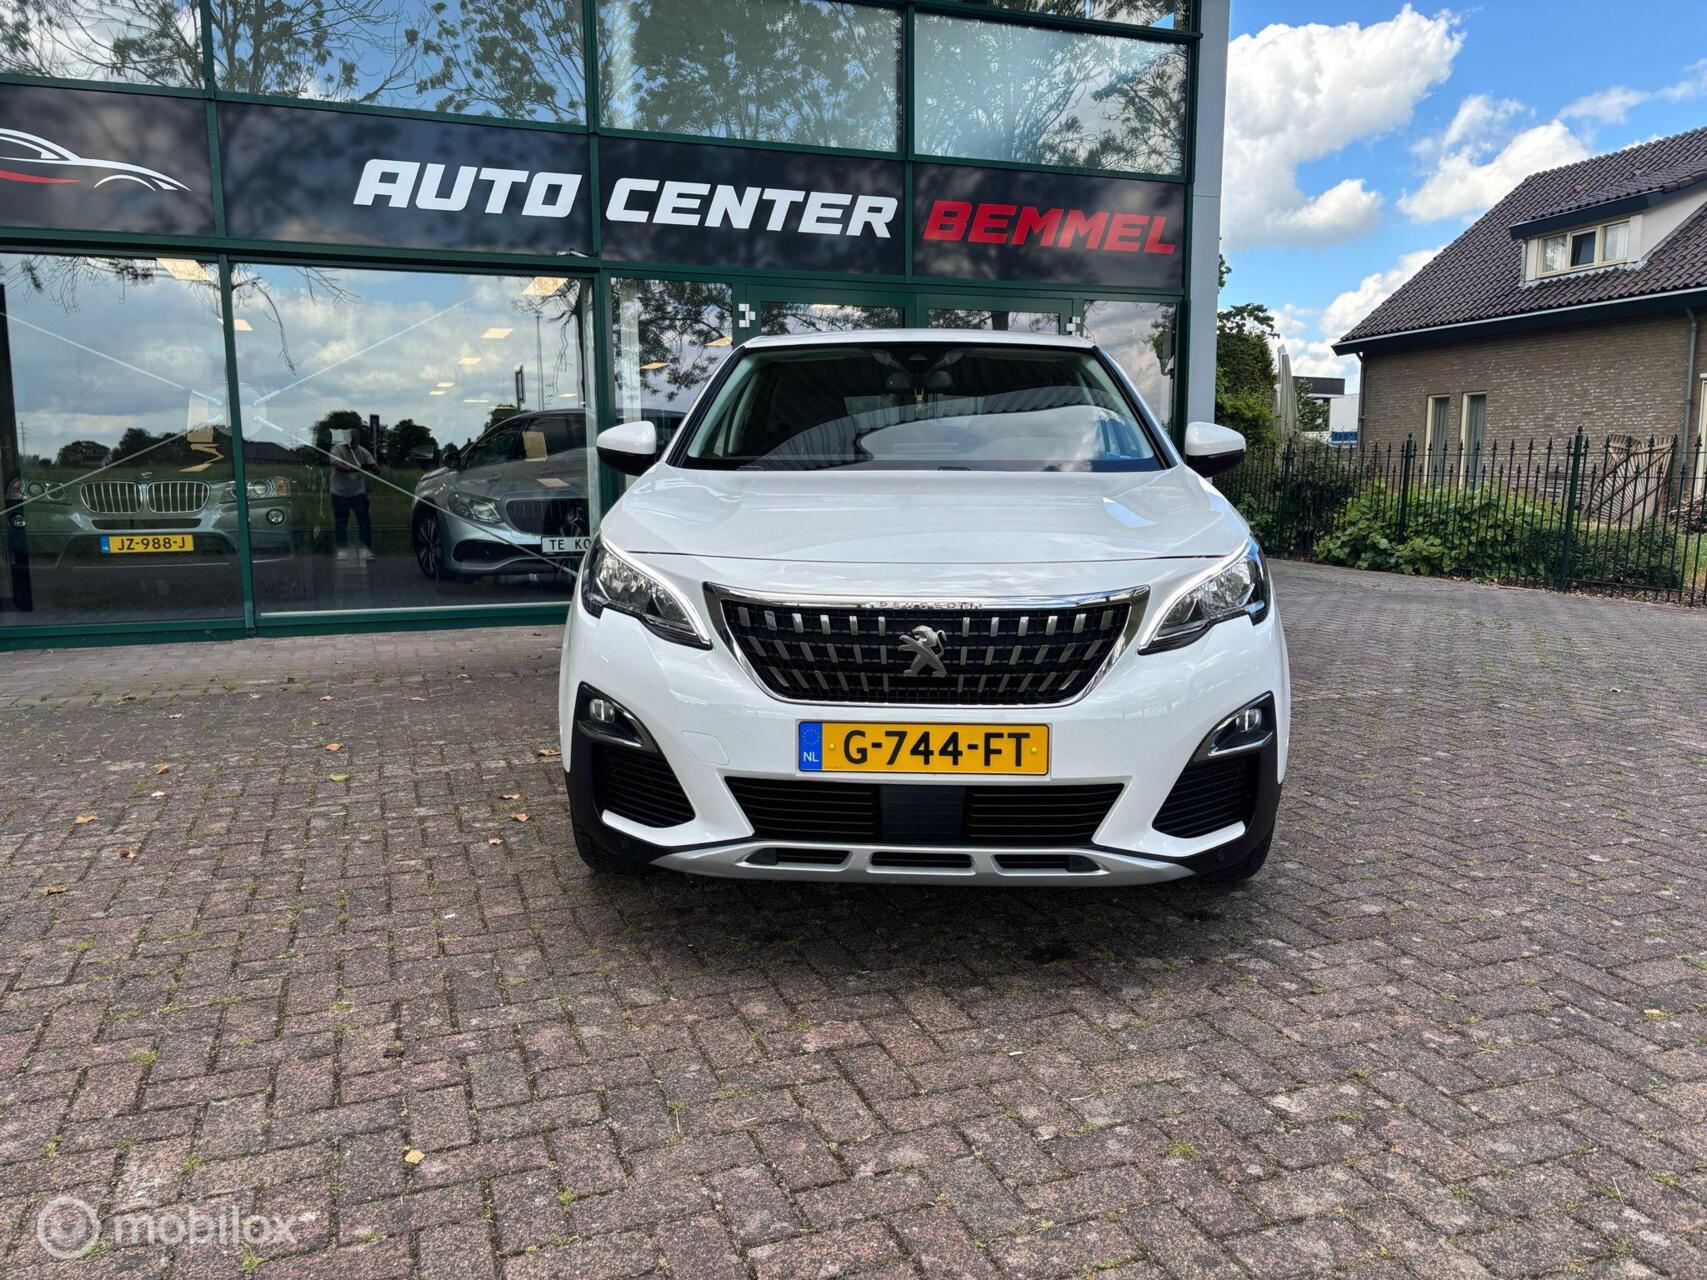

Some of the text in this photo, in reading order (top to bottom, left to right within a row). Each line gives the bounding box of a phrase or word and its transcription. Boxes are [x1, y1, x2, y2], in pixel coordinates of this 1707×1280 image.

[353, 158, 1176, 255] AUTO CENTER BEMMEL
[117, 536, 186, 551] JZ-988-J
[549, 539, 565, 550] TE
[843, 729, 1031, 767] G-744-FT
[802, 751, 819, 762] NL
